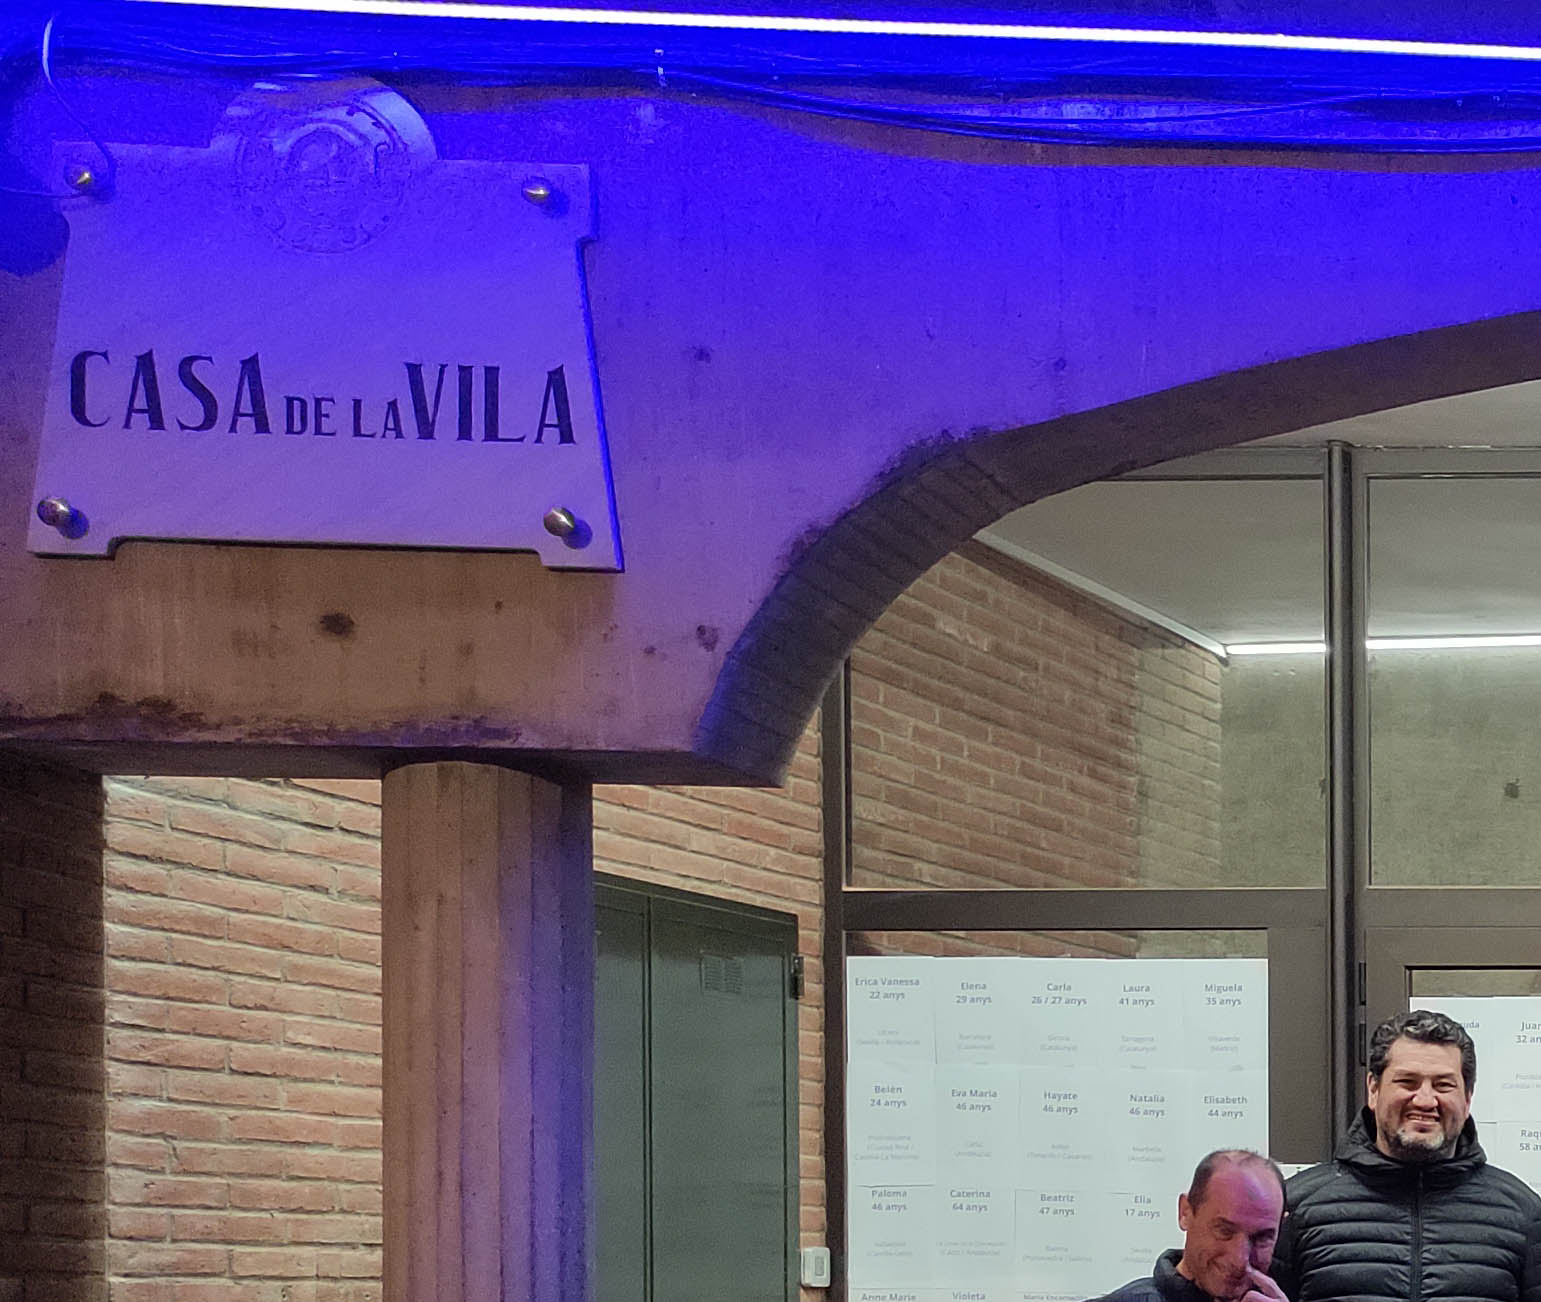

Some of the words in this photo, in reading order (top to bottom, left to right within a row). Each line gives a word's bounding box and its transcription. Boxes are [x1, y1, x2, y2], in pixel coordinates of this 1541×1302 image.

[69, 347, 273, 435] CASA
[282, 393, 338, 438] DE
[351, 396, 406, 441] LA
[402, 362, 578, 446] VILA
[855, 976, 879, 986] Erica
[880, 976, 920, 986] Vanessa
[959, 981, 988, 992] Elena
[1046, 981, 1073, 992] Carla
[1122, 983, 1152, 993] Laura
[1203, 982, 1244, 995] Miguela
[869, 990, 882, 1001] 22
[883, 991, 906, 1003] anys
[956, 994, 968, 1005] 29
[970, 995, 993, 1006] anys
[1031, 995, 1043, 1006] 26
[1050, 995, 1063, 1006] 27
[1064, 997, 1089, 1008] anys
[1118, 996, 1130, 1007] 41
[1132, 997, 1156, 1009] anys
[1206, 996, 1218, 1007] 35
[1219, 997, 1243, 1008] anys
[1516, 1034, 1528, 1045] 32
[951, 1087, 968, 1098] Eva
[1043, 1090, 1079, 1103] Hayate
[1129, 1093, 1166, 1104] Natalia
[870, 1097, 882, 1108] 24
[883, 1099, 908, 1110] anys
[1203, 1094, 1249, 1106] Elisabeth
[955, 1102, 967, 1112] 46
[968, 1102, 993, 1113] anys
[1042, 1104, 1055, 1114] 46
[1056, 1105, 1080, 1116] anys
[1129, 1107, 1141, 1117] 46
[1142, 1108, 1166, 1119] anys
[1207, 1108, 1220, 1119] 44
[1221, 1109, 1245, 1120] anys
[1519, 1141, 1532, 1152] 58
[871, 1189, 908, 1200] Paloma
[949, 1188, 992, 1200] Caterina
[1039, 1192, 1075, 1203] Beatriz
[871, 1202, 884, 1212] 46
[885, 1203, 908, 1214] anys
[952, 1202, 964, 1213] 64
[965, 1202, 989, 1213] anys
[1038, 1205, 1052, 1216] 47
[1053, 1206, 1076, 1217] anys
[1125, 1208, 1137, 1219] 17
[1138, 1209, 1162, 1220] anys
[861, 1292, 888, 1302] Anne
[889, 1292, 917, 1302] Marie
[952, 1291, 987, 1302] Violeta
